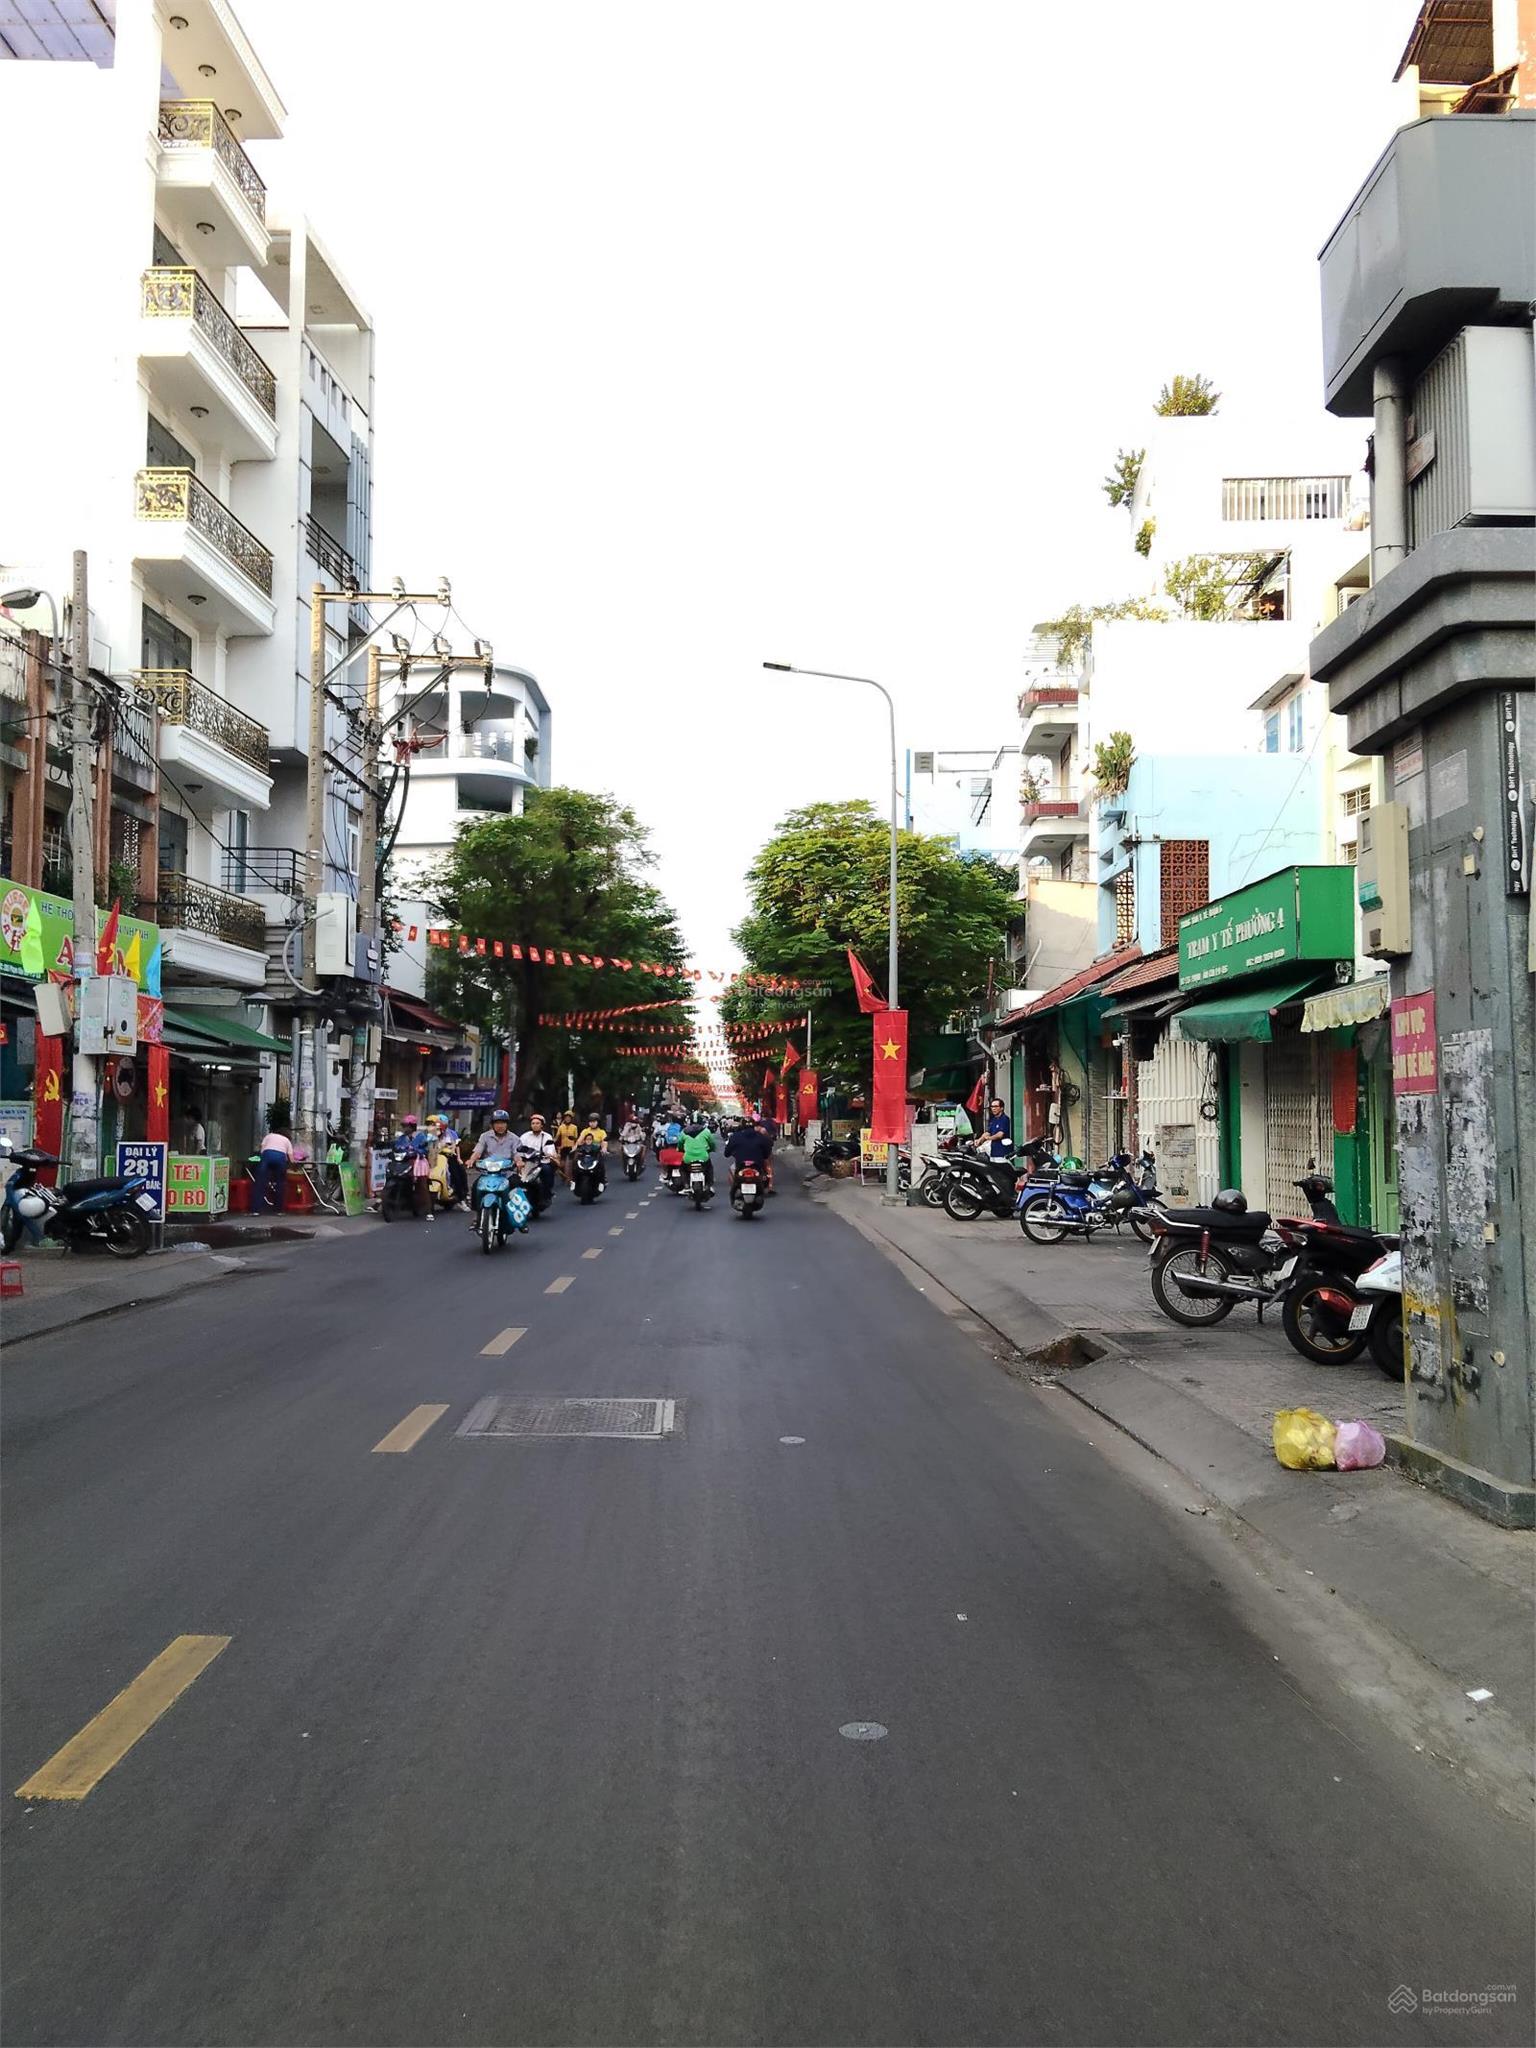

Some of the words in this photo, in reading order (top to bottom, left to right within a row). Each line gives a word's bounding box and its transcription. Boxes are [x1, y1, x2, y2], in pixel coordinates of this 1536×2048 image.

[1186, 935, 1210, 960] TRẠM
[1211, 932, 1218, 951] Y
[1220, 917, 1234, 948] TẾ
[1235, 907, 1276, 944] PHƯỜNG
[1276, 907, 1285, 928] 4
[125, 1147, 143, 1158] ĐẠI
[145, 1146, 157, 1157] LÝ
[123, 1159, 159, 1177] 281
